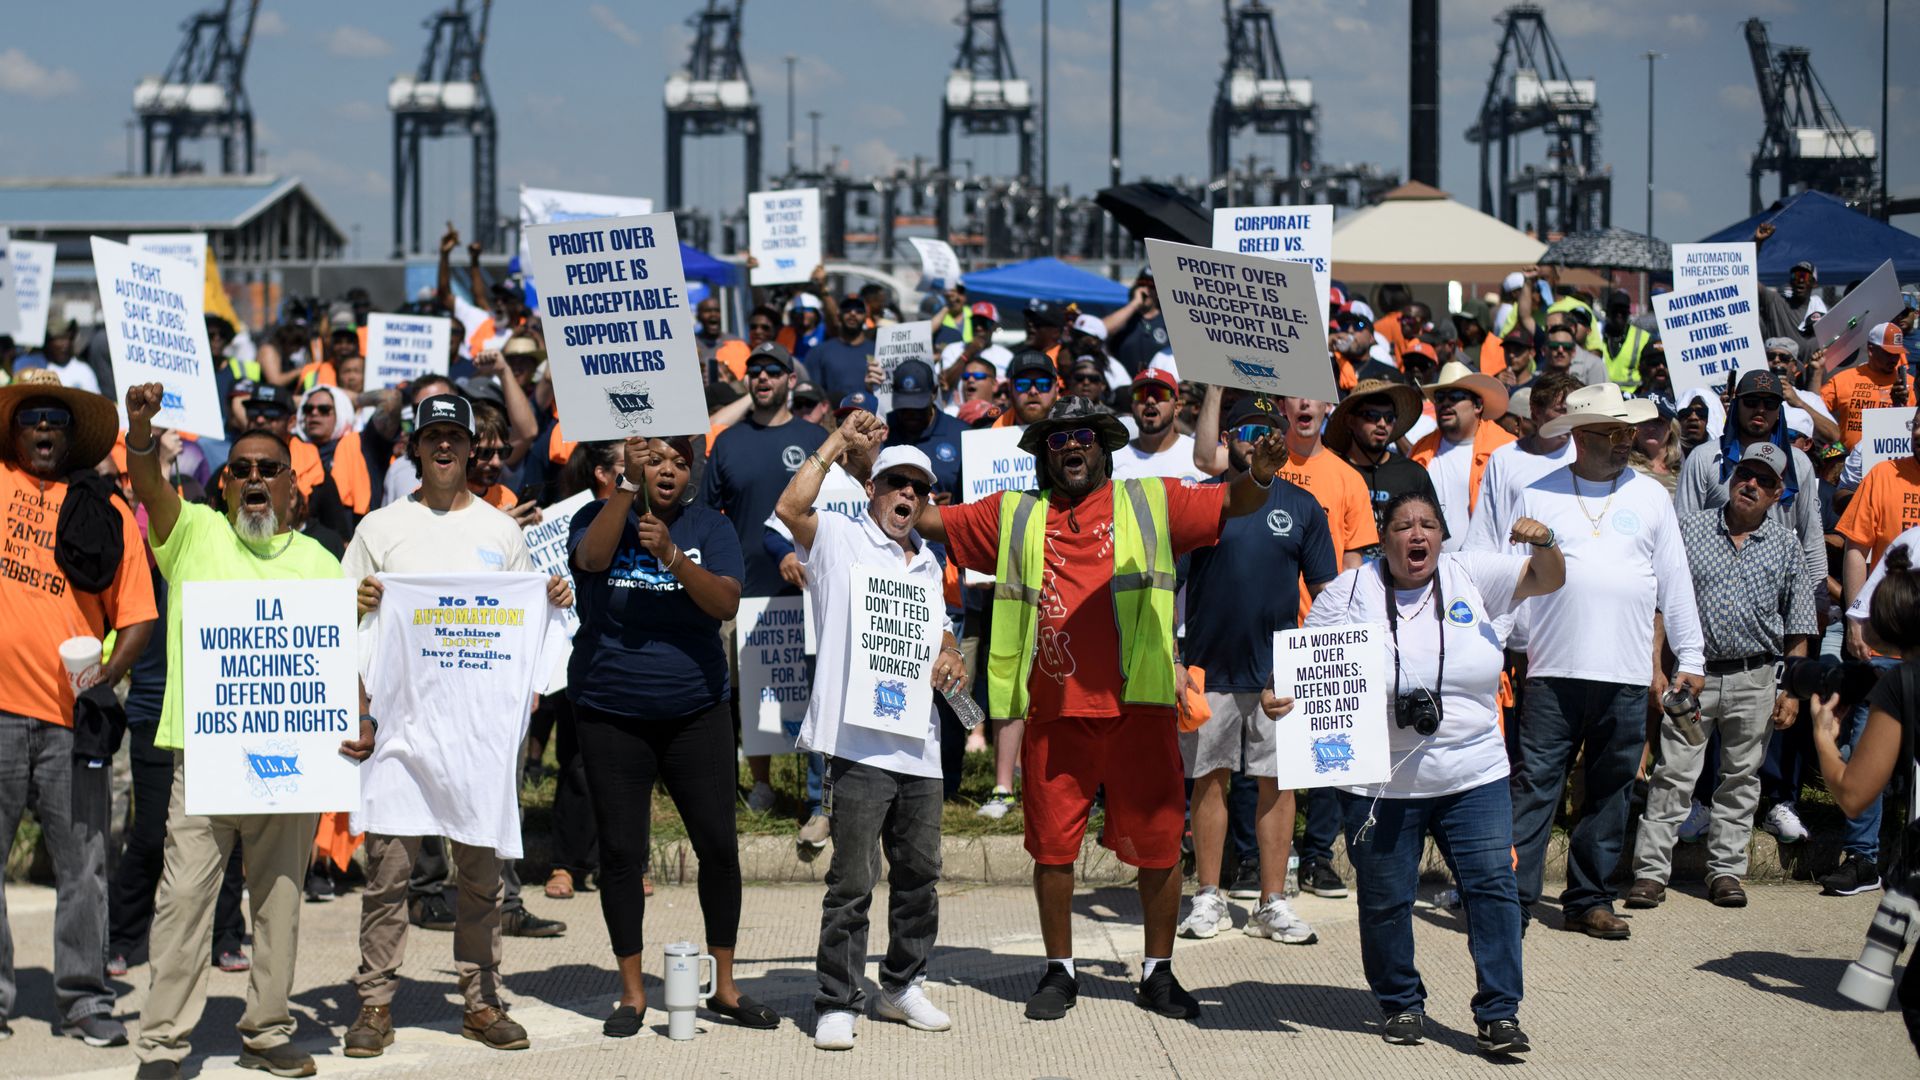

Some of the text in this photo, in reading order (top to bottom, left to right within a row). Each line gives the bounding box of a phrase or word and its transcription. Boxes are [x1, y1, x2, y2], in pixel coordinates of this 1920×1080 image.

[1235, 215, 1311, 232] CORPORATE
[548, 226, 655, 256] PROFIT OVER
[1239, 237, 1304, 252] GREED VS.
[1687, 252, 1742, 264] AUTOMATION
[131, 262, 161, 284] FIGHT
[566, 258, 648, 286] PEOPLE IS
[1176, 256, 1288, 288] PROFIT OVER
[1680, 265, 1749, 277] THREATENS OUR
[116, 279, 188, 316] AUTOMATION,
[1192, 276, 1279, 303] PEOPLE IS
[1668, 284, 1739, 312] AUTOMATION
[547, 287, 679, 317] UNACCEPTABLE:
[1172, 289, 1308, 325] UNACCEPTABLE:
[124, 302, 186, 332] SAVE JOBS:
[1188, 308, 1300, 340] SUPPORT ILA
[1664, 300, 1750, 330] THREATENS OUR
[122, 322, 196, 355] ILA DEMANDS
[564, 318, 672, 347] SUPPORT ILA
[891, 330, 911, 342] FIGHT
[1204, 328, 1290, 354] WORKERS
[1689, 322, 1733, 342] FUTURE:
[1681, 336, 1749, 362] STAND WITH
[126, 344, 199, 376] JOB SECURITY
[581, 350, 665, 376] WORKERS
[881, 357, 900, 369] SAVE
[1698, 357, 1740, 376] THE ILA
[1852, 391, 1871, 399] FEED
[1874, 437, 1912, 454] WORK
[992, 456, 1036, 474] NO WO
[1754, 452, 1774, 463] ARIAT
[973, 476, 1025, 494] WITHOUT
[8, 502, 44, 524] FEED
[7, 518, 56, 550] FAMIL
[4, 539, 30, 559] NOT
[608, 578, 674, 591] DEMOCRATIC
[868, 577, 926, 603] MACHINES
[256, 598, 283, 621] ILA
[439, 596, 499, 607] No To
[866, 596, 930, 622] DON'T FEED
[413, 608, 525, 625] AUTOMATION!
[757, 610, 804, 626] AUTOMA
[200, 625, 340, 650] WORKERS OVER
[435, 627, 501, 637] Machines
[746, 630, 784, 646] HURTS
[870, 615, 924, 641] FAMILIES:
[862, 632, 930, 662] SUPPORT ILA
[1289, 630, 1368, 650] ILA WORKERS
[422, 648, 511, 660] have families
[761, 649, 805, 665] ILA STA
[1314, 648, 1344, 663] OVER
[221, 654, 320, 677] MACHINES:
[458, 660, 492, 670] feed.
[772, 668, 795, 683] FOR
[870, 654, 920, 680] WORKERS
[1297, 663, 1362, 682] MACHINES:
[216, 682, 326, 706] DEFEND OUR
[1294, 679, 1367, 700] DEFEND OUR
[1304, 697, 1359, 715] JOBS AND
[194, 709, 348, 734] JOBS AND RIGHTS
[1311, 714, 1353, 731] RIGHTS
